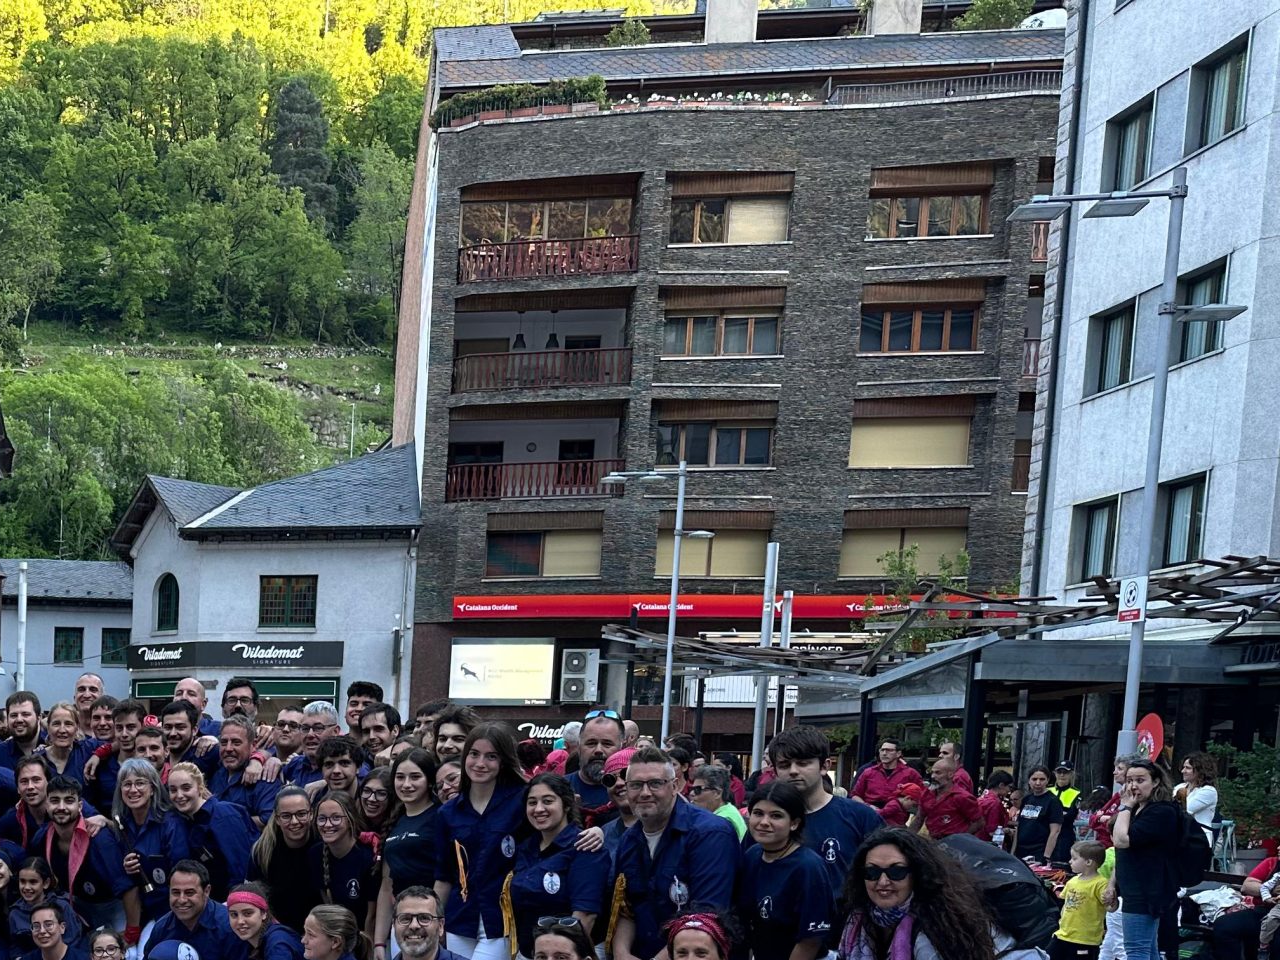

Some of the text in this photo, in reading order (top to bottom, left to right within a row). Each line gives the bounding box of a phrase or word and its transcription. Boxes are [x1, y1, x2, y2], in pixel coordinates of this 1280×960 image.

[138, 646, 183, 661] Viladomat
[232, 643, 305, 659] Viladomat
[517, 722, 565, 739] Vilad
